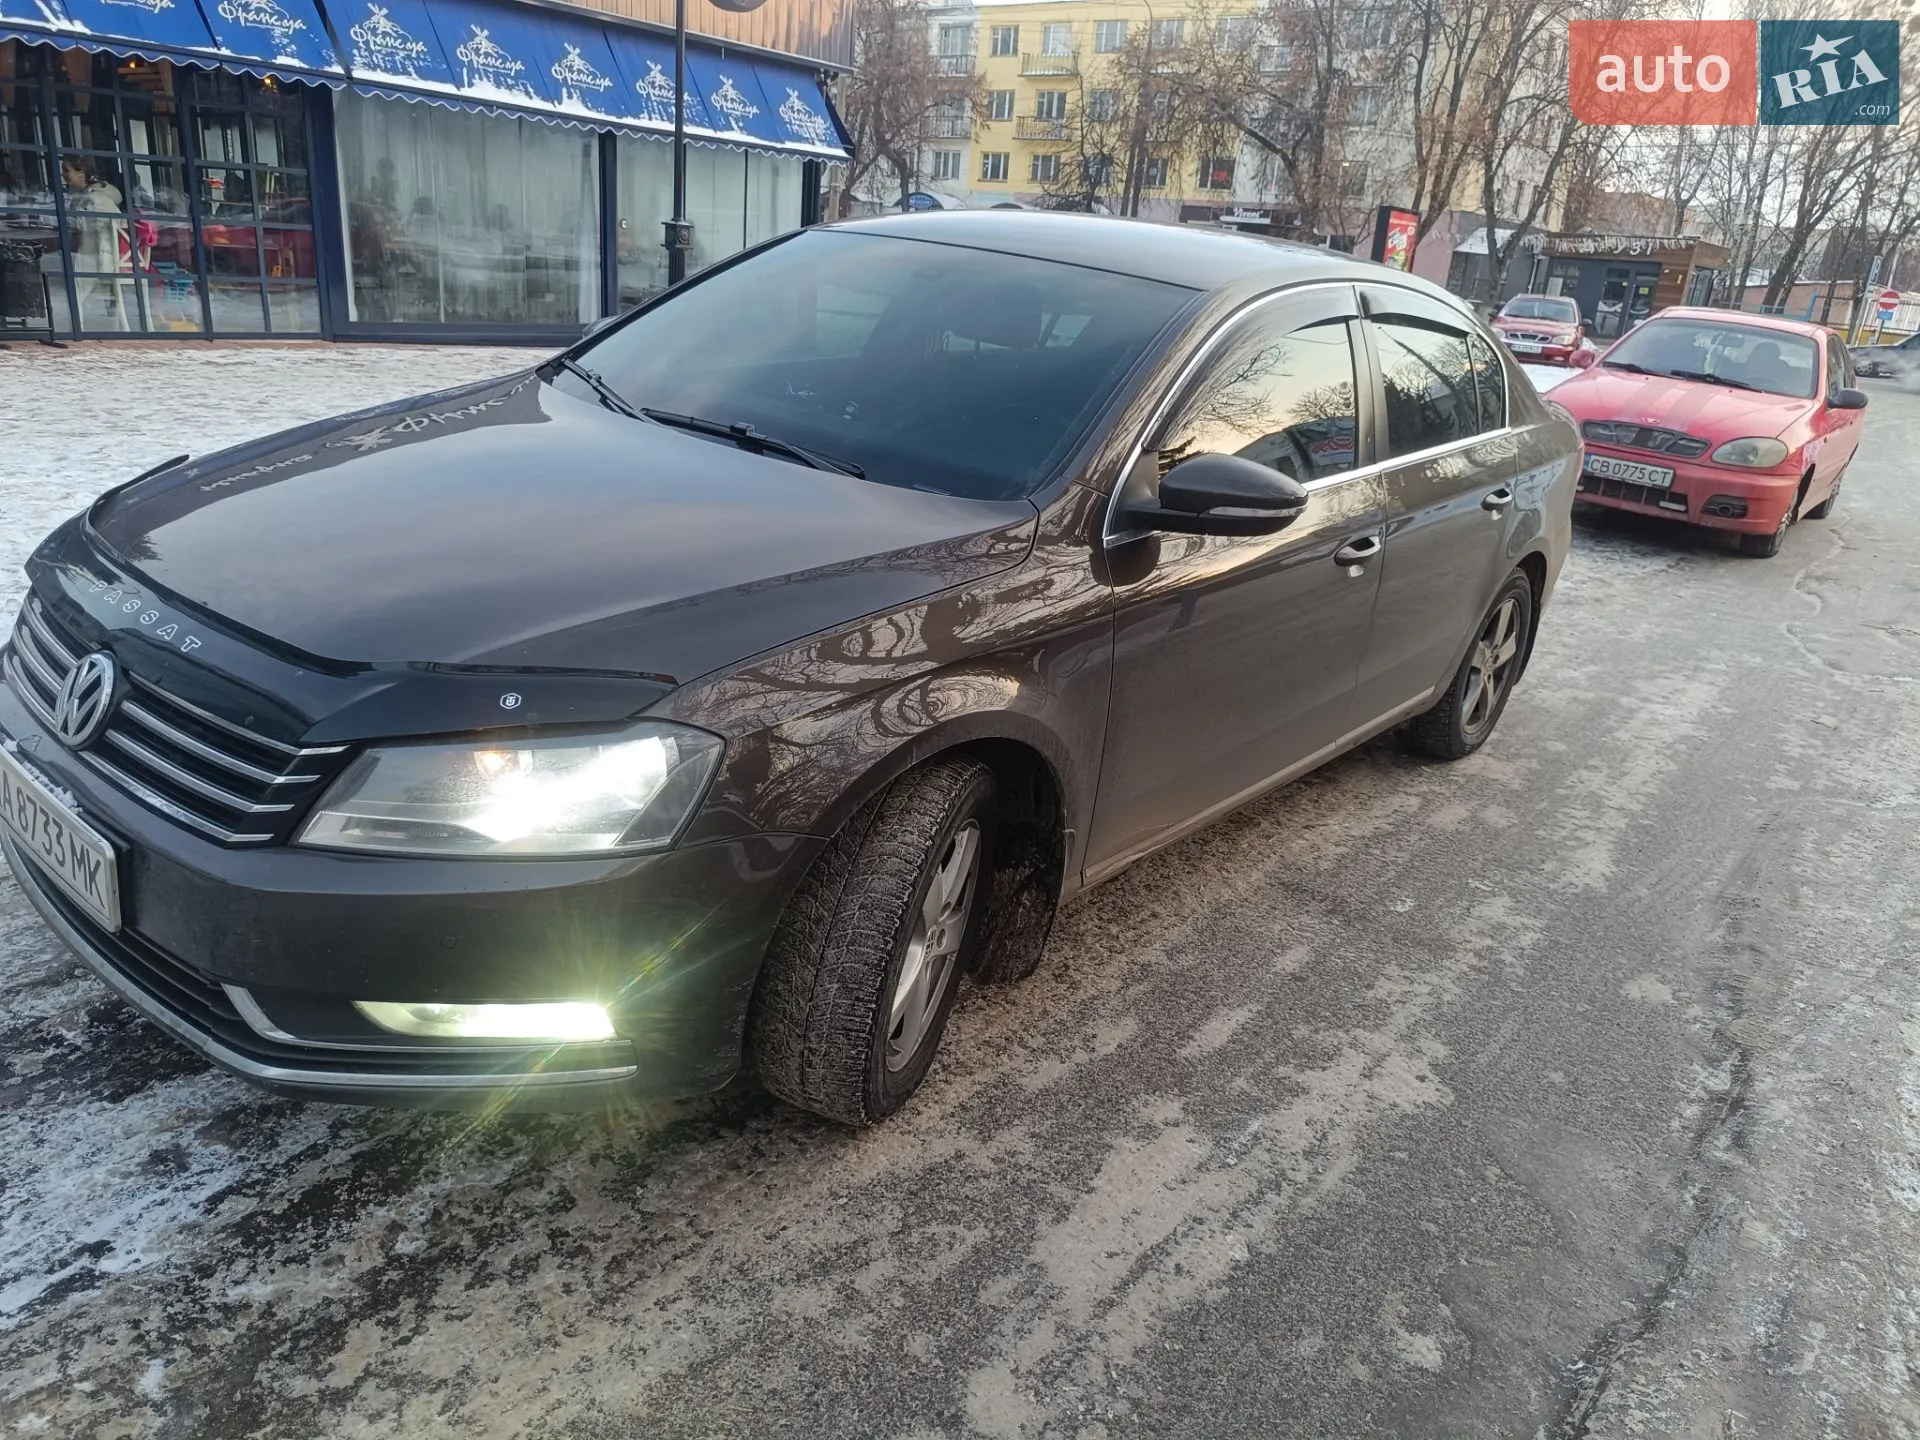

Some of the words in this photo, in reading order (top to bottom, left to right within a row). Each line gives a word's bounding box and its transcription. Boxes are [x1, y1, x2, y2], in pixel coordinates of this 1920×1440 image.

[1590, 458, 1610, 473] CB
[1612, 462, 1646, 480] 0775
[1648, 469, 1671, 484] CT
[89, 580, 202, 652] PASSAT
[17, 785, 66, 868] 8733
[69, 831, 106, 910] MK
